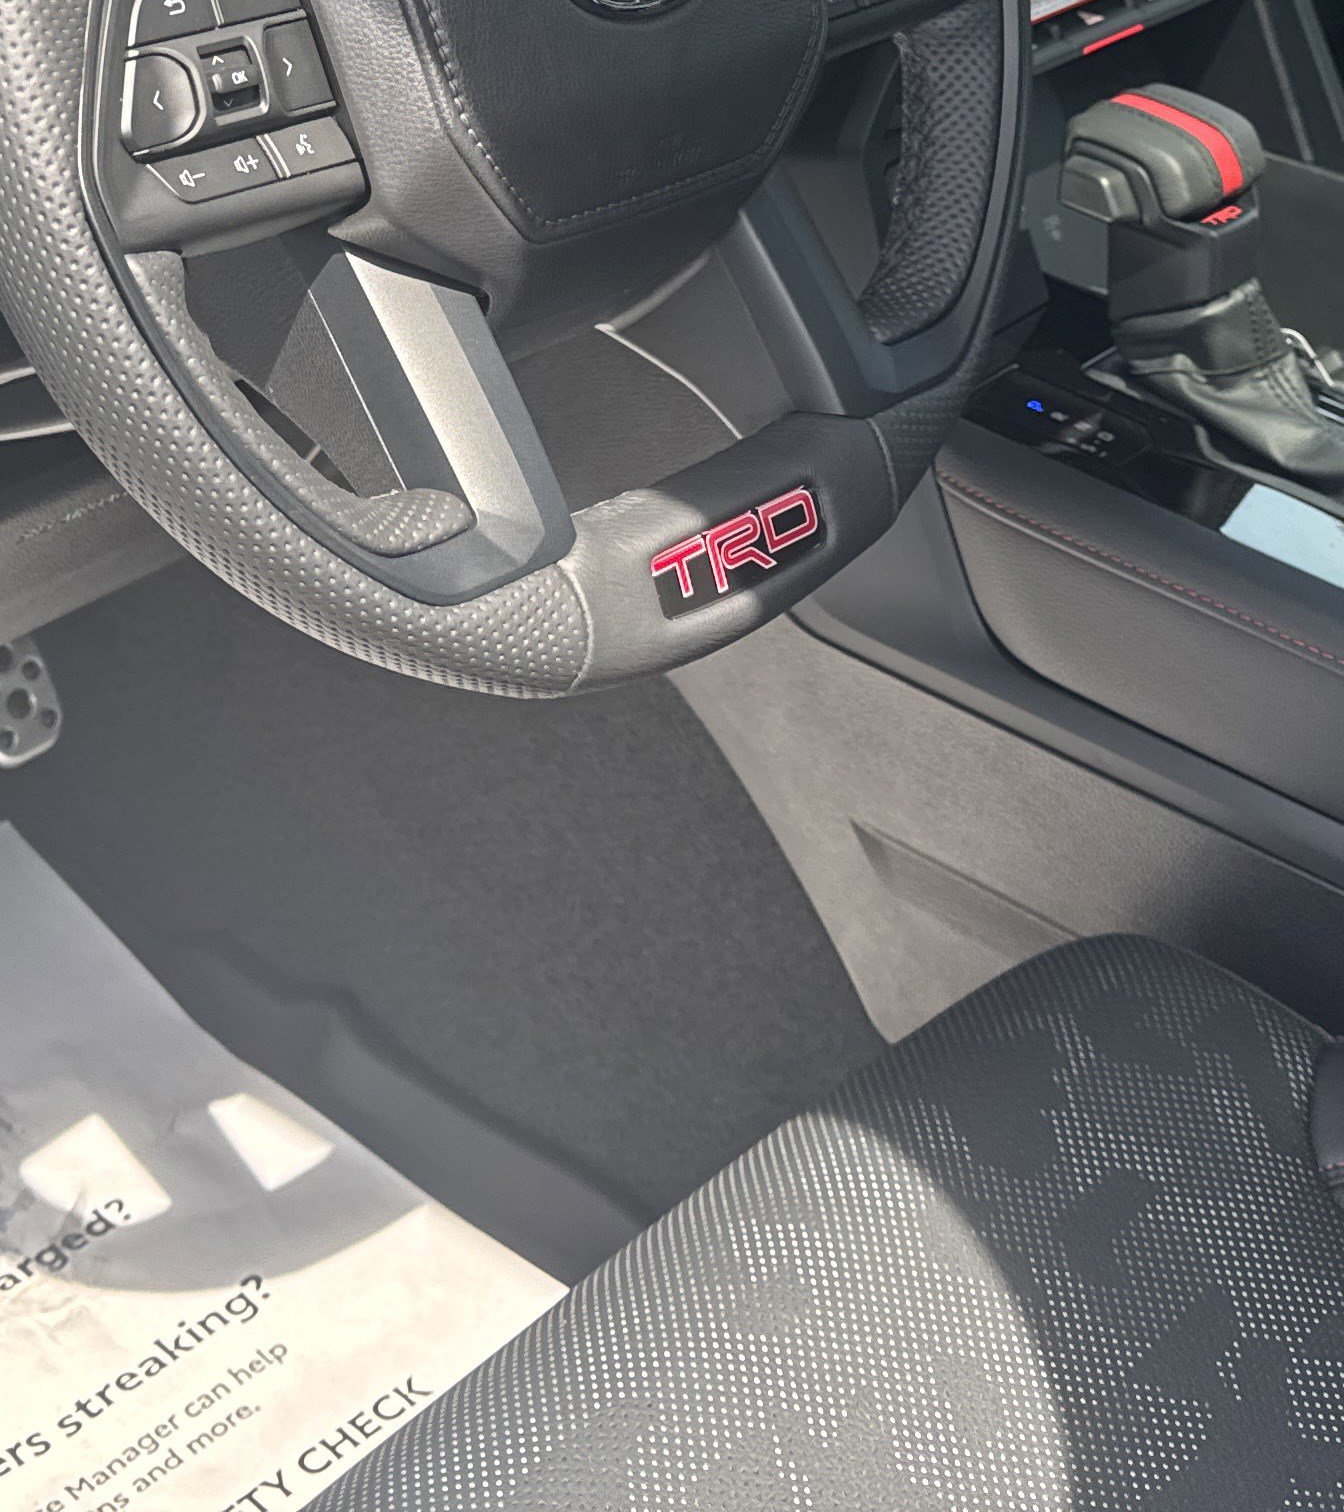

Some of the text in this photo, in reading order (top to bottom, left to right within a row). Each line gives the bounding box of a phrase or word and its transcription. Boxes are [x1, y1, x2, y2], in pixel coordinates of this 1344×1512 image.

[231, 70, 248, 85] OK
[651, 485, 818, 598] TRD
[57, 1274, 272, 1438] streaking?
[64, 1343, 289, 1501] Manager can help
[132, 1448, 185, 1493] and
[186, 1404, 261, 1455] more.
[222, 1375, 434, 1512] TY CHECK
